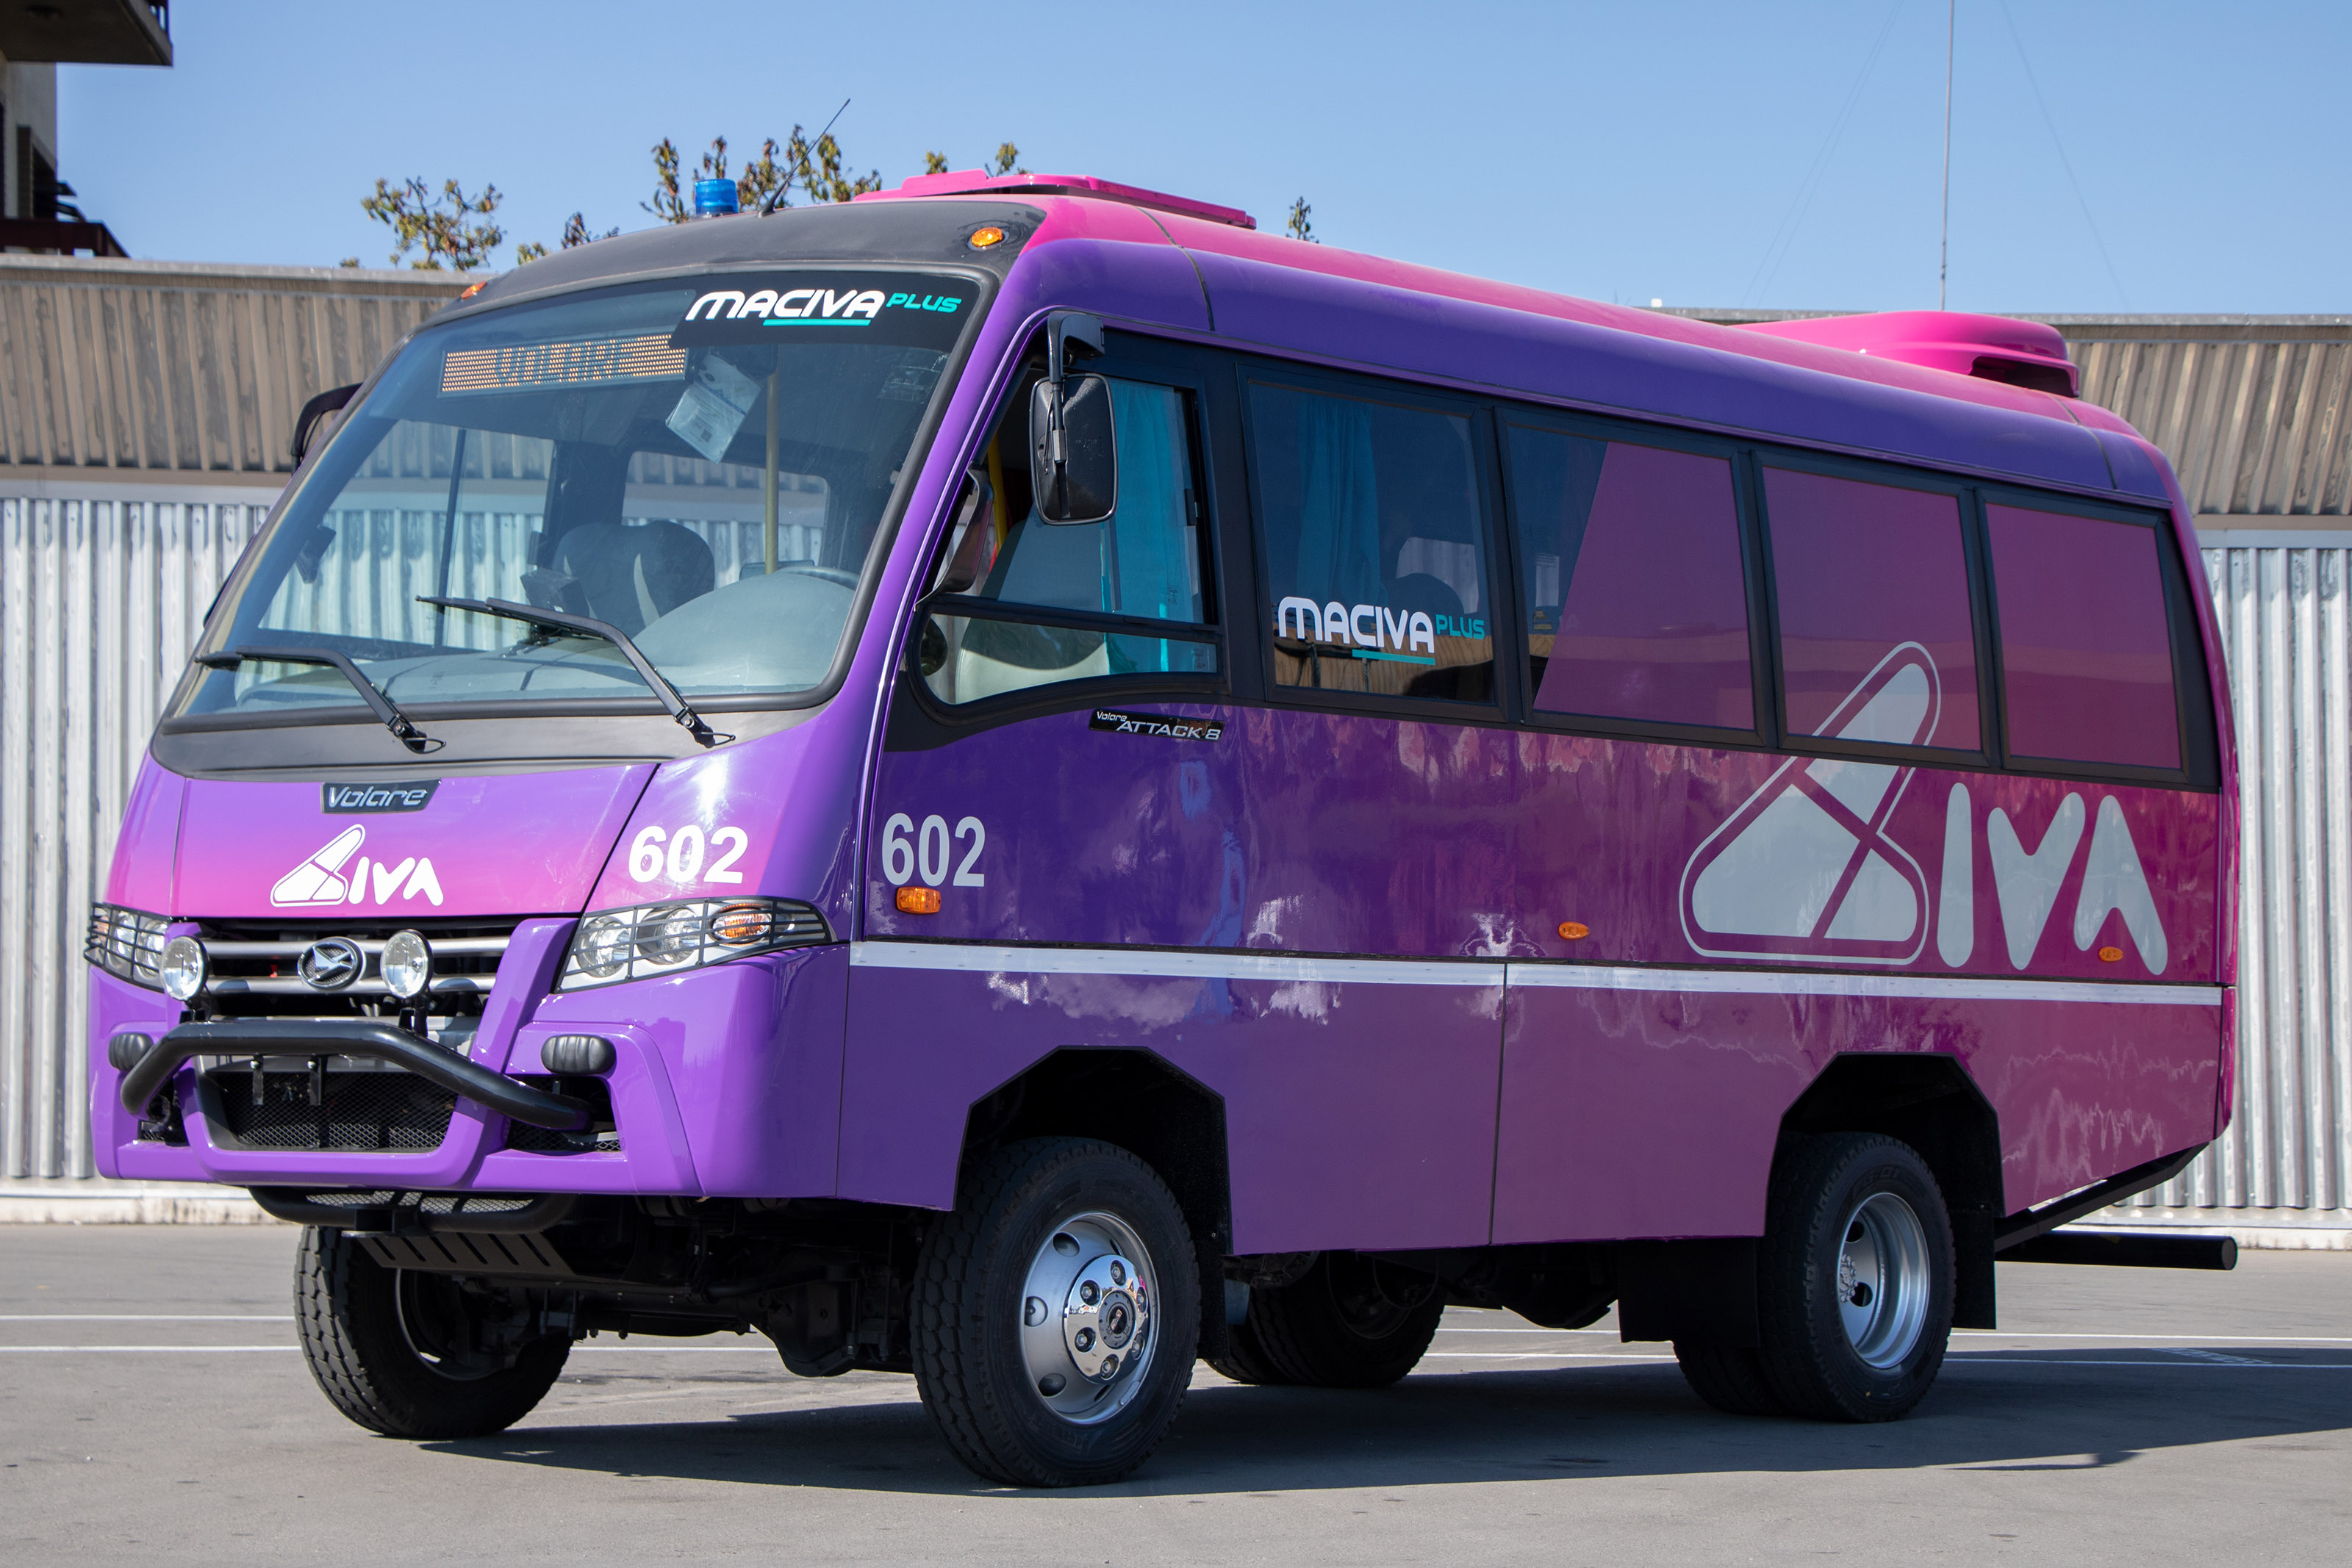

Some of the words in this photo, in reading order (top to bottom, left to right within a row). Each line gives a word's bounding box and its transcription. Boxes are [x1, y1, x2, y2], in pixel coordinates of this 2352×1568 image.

[685, 289, 886, 321] MACIVA
[886, 292, 962, 314] PLUS
[1277, 596, 1435, 653] MACIVA
[1435, 614, 1485, 640] PLUS
[1096, 711, 1127, 722] Volare
[1116, 720, 1203, 739] ATTACK
[1205, 728, 1222, 741] 8
[328, 785, 428, 808] Volare
[628, 824, 749, 885] 602
[881, 812, 986, 888] 602
